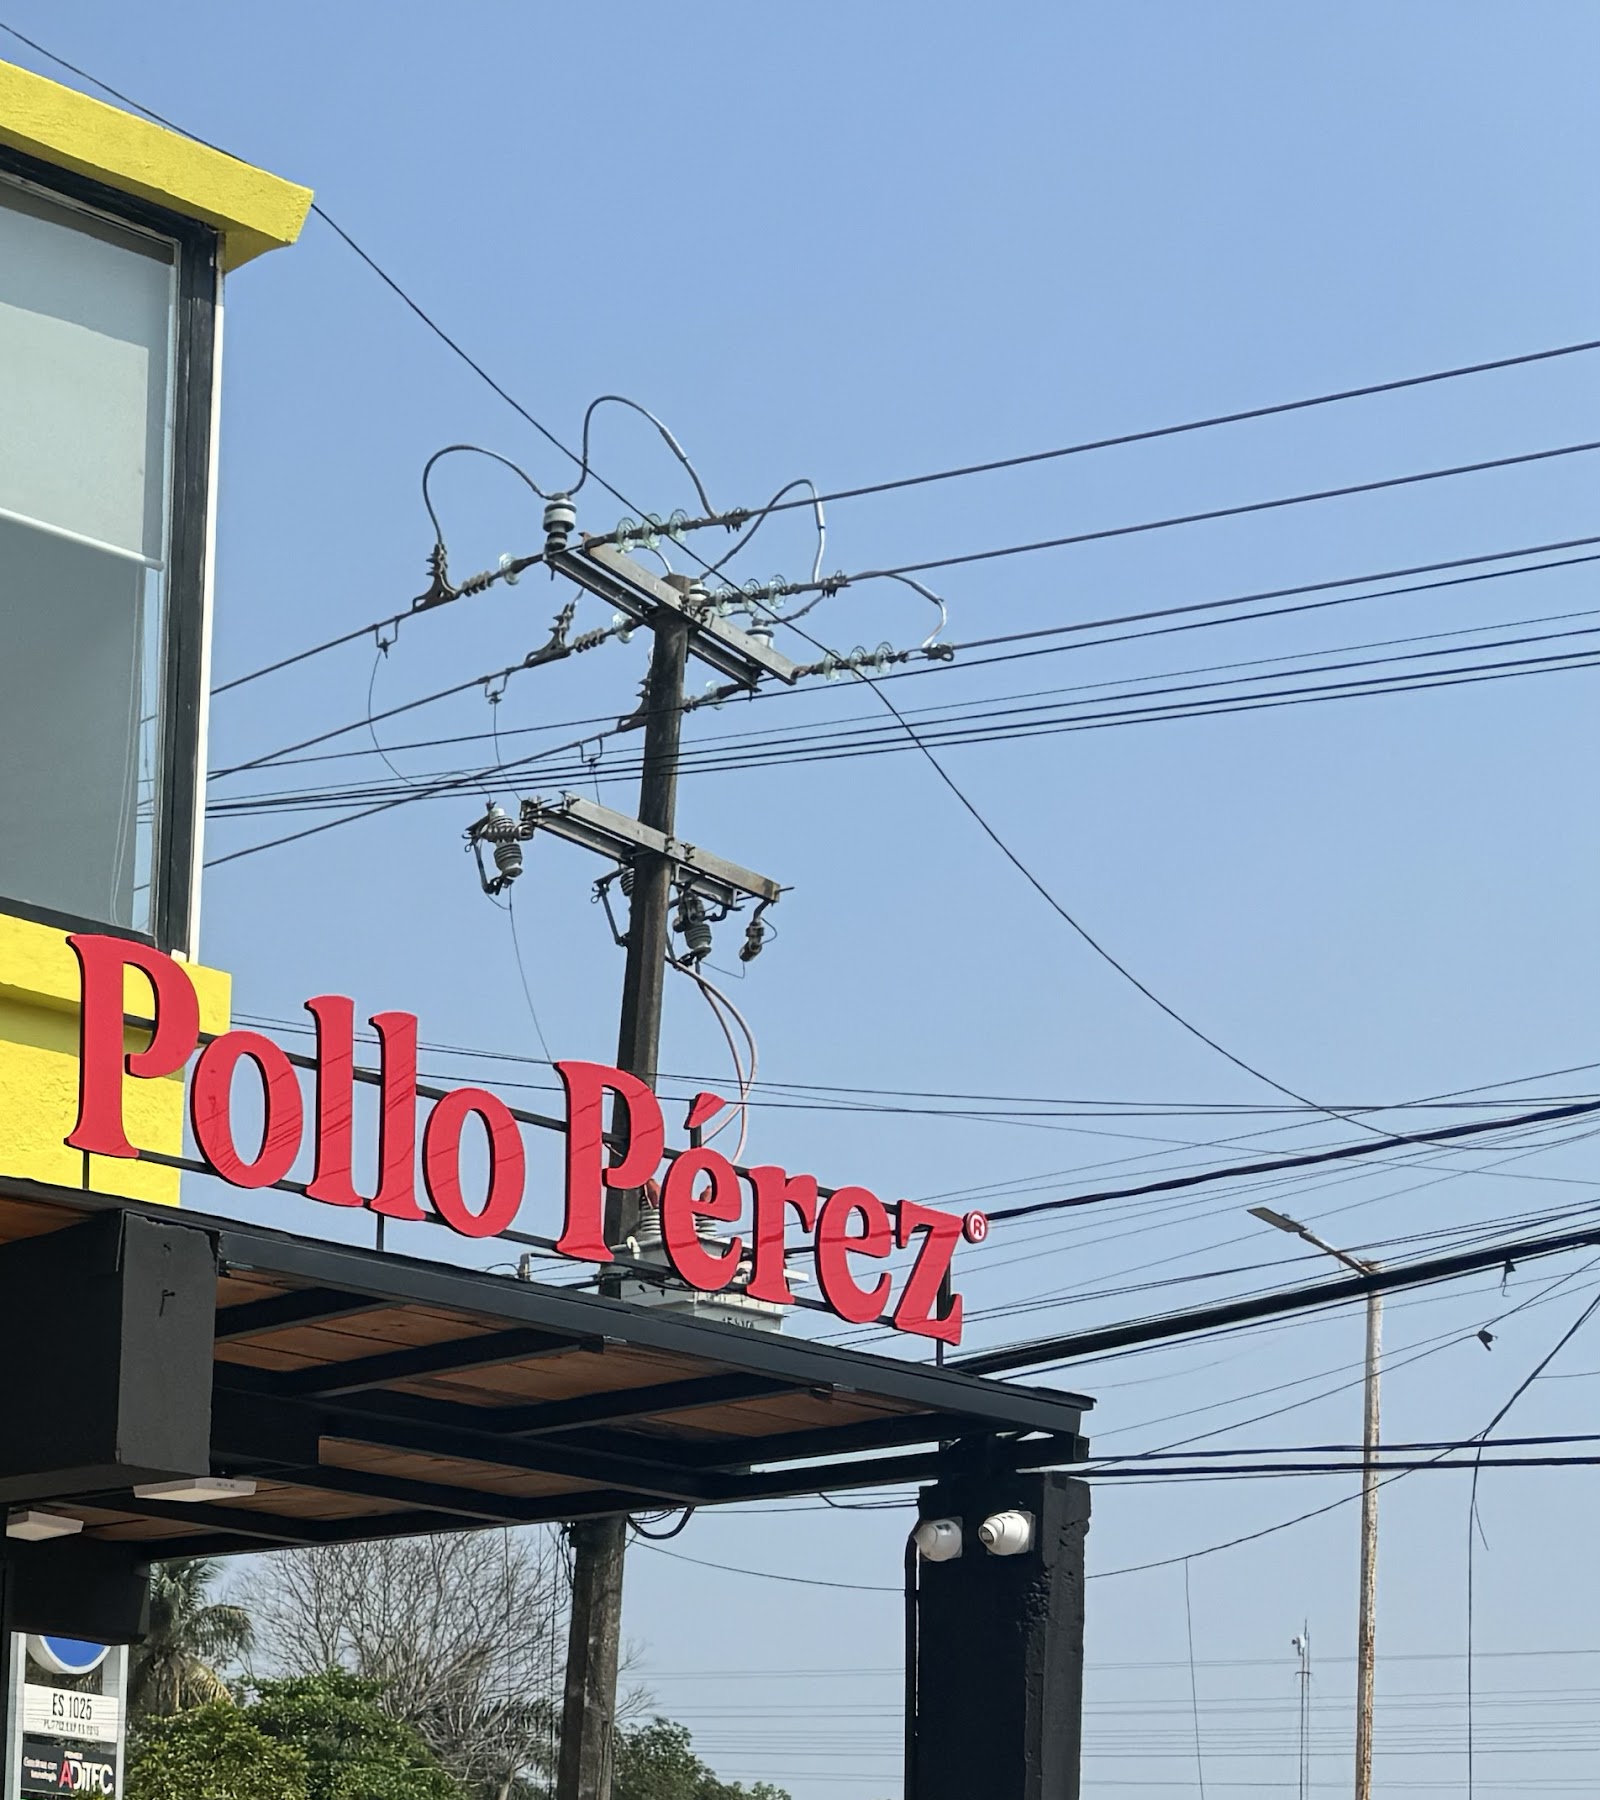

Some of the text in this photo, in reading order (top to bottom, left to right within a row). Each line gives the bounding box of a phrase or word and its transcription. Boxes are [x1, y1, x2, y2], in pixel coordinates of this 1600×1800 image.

[64, 933, 964, 1347] Pollo Pérez
[52, 1693, 92, 1721] ES 1025
